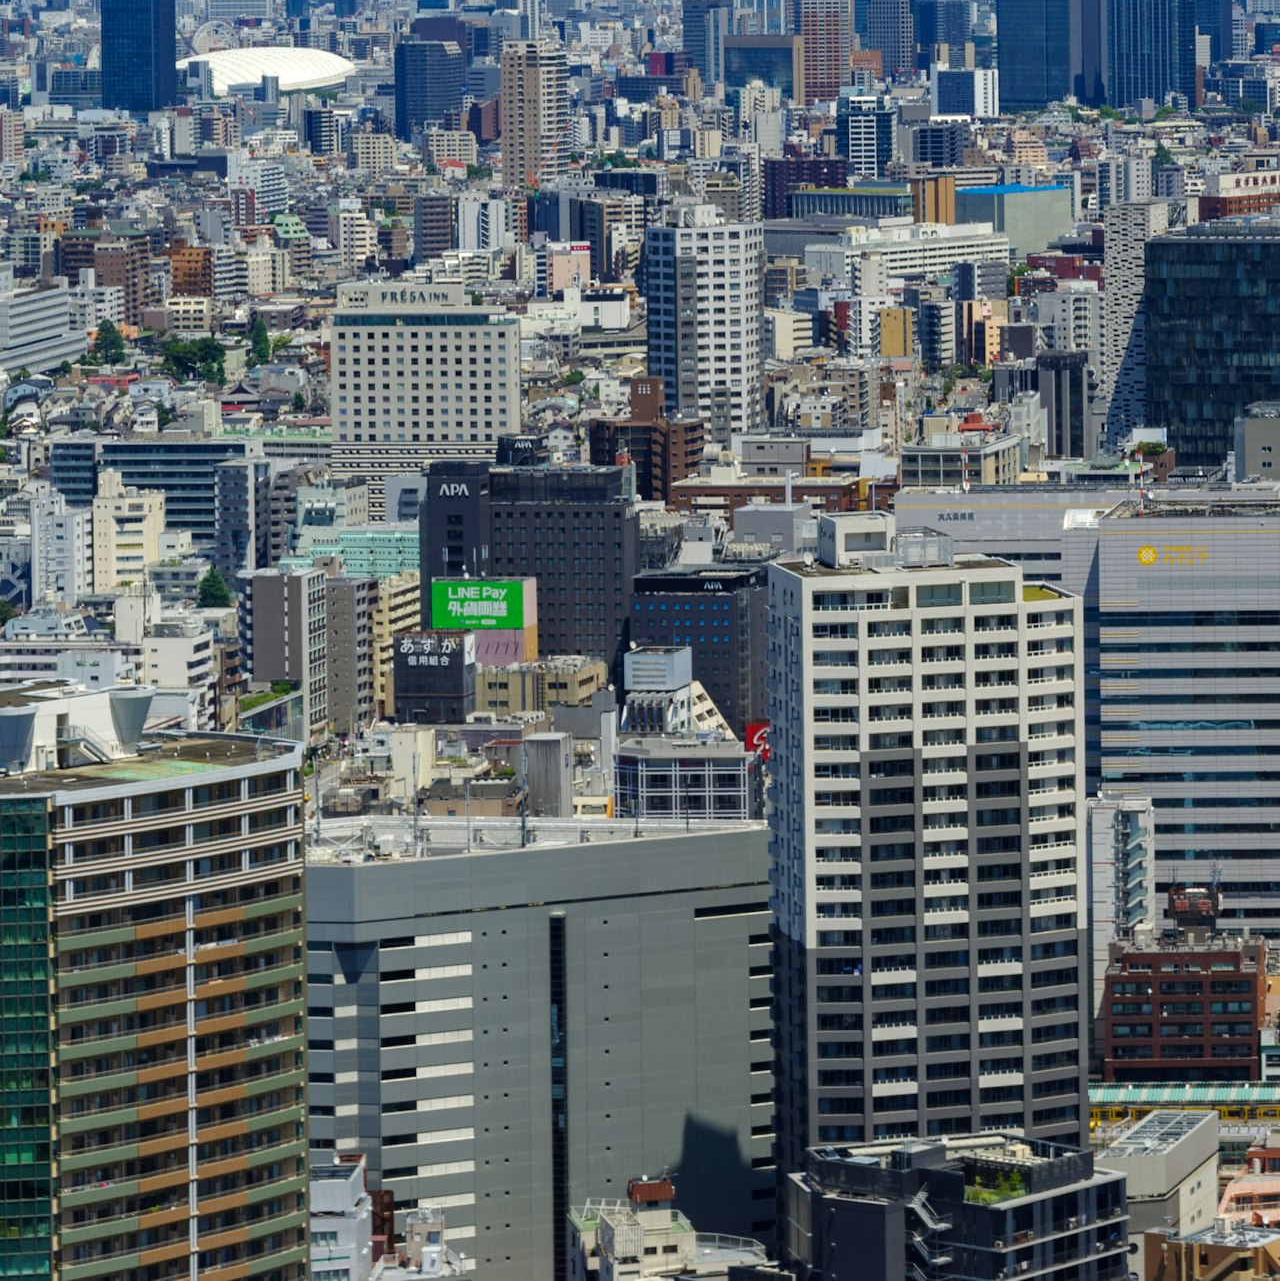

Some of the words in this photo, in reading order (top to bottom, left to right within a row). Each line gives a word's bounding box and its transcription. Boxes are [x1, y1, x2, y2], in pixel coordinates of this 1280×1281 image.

[381, 288, 426, 304] FRÉSA
[429, 292, 449, 303] INN
[515, 440, 532, 449] APA
[439, 484, 470, 497] APA
[704, 582, 722, 590] APA
[448, 587, 480, 599] LINE
[482, 587, 508, 600] Pay
[400, 637, 456, 654] あすか
[408, 656, 450, 667] 信用組合
